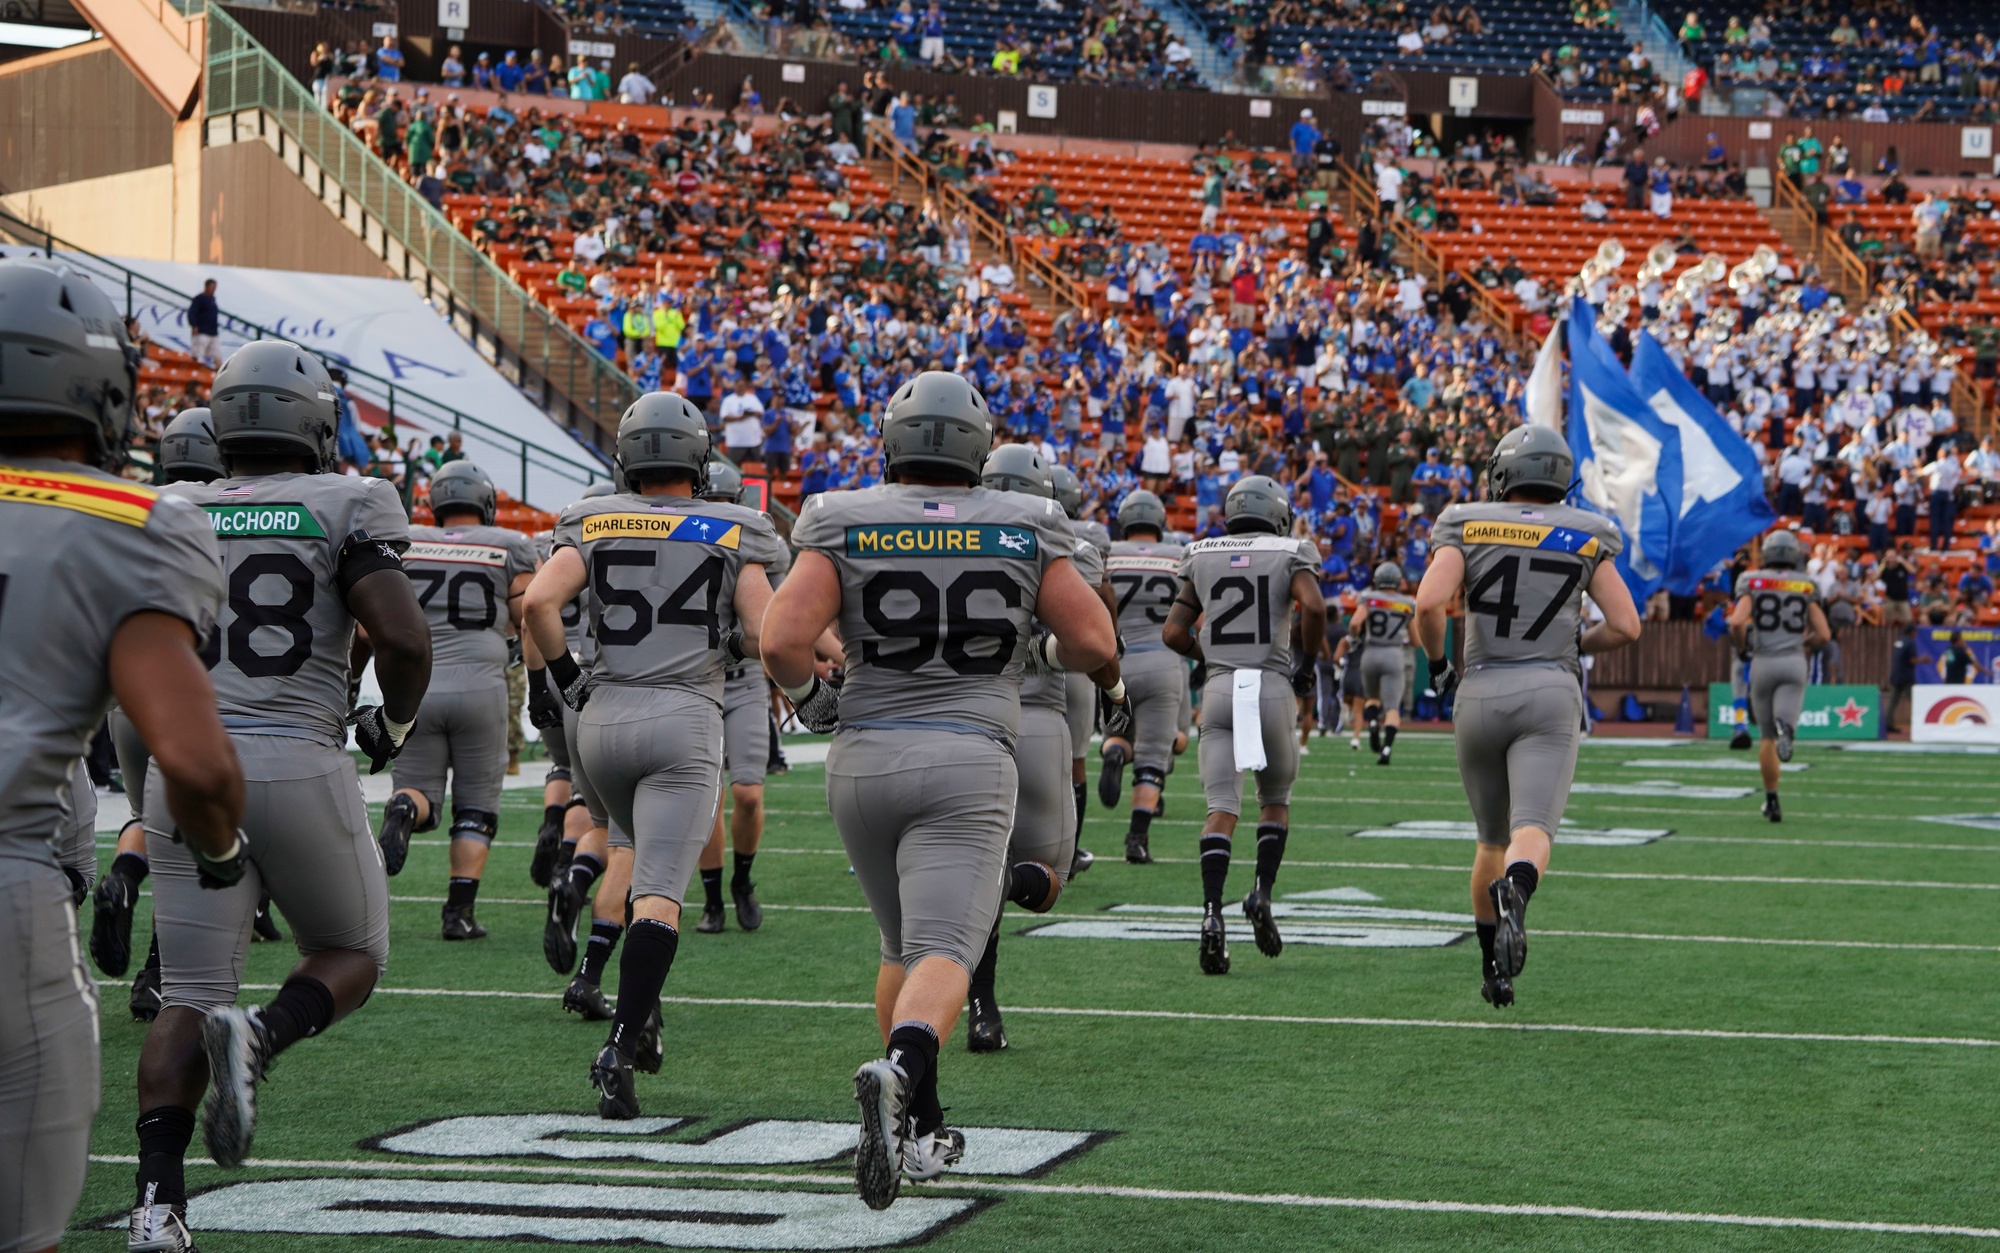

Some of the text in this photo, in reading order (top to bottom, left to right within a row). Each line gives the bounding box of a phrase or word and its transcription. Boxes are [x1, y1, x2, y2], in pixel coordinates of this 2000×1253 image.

[448, 2, 460, 17] R
[1036, 91, 1049, 108] S
[1458, 84, 1470, 98] T
[1970, 134, 1983, 148] U
[207, 511, 300, 531] McCHORD
[585, 519, 671, 534] CHARLESTON
[858, 530, 981, 551] McGUIRE
[1465, 526, 1540, 542] CHARLESTON
[406, 545, 487, 558] RIGHT-PATT
[1193, 541, 1255, 550] ELMENDORF
[402, 569, 497, 631] 70
[593, 550, 725, 650] 54
[1111, 575, 1177, 624] 73
[1469, 554, 1583, 642] 47
[207, 553, 315, 678] 8
[1211, 575, 1271, 645] 21
[1756, 593, 1807, 633] 83
[862, 570, 1022, 675] 96
[1369, 610, 1407, 640] 87
